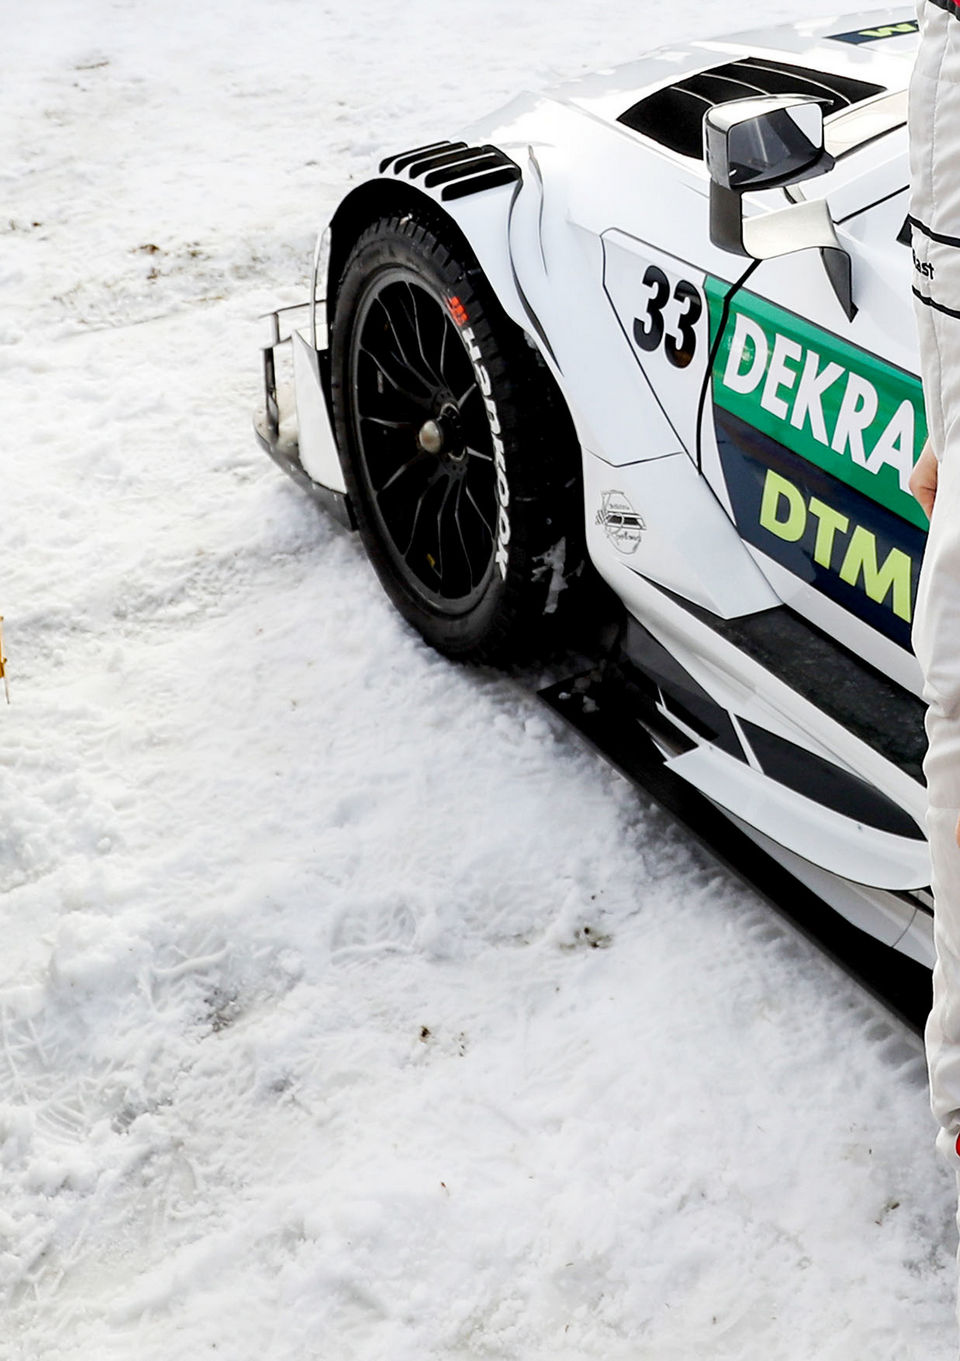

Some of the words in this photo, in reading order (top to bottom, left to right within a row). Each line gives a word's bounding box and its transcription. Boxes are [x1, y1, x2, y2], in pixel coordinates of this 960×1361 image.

[633, 264, 701, 369] 33
[911, 246, 935, 280] ast
[722, 312, 917, 497] DEKRA
[759, 468, 912, 624] DTM
